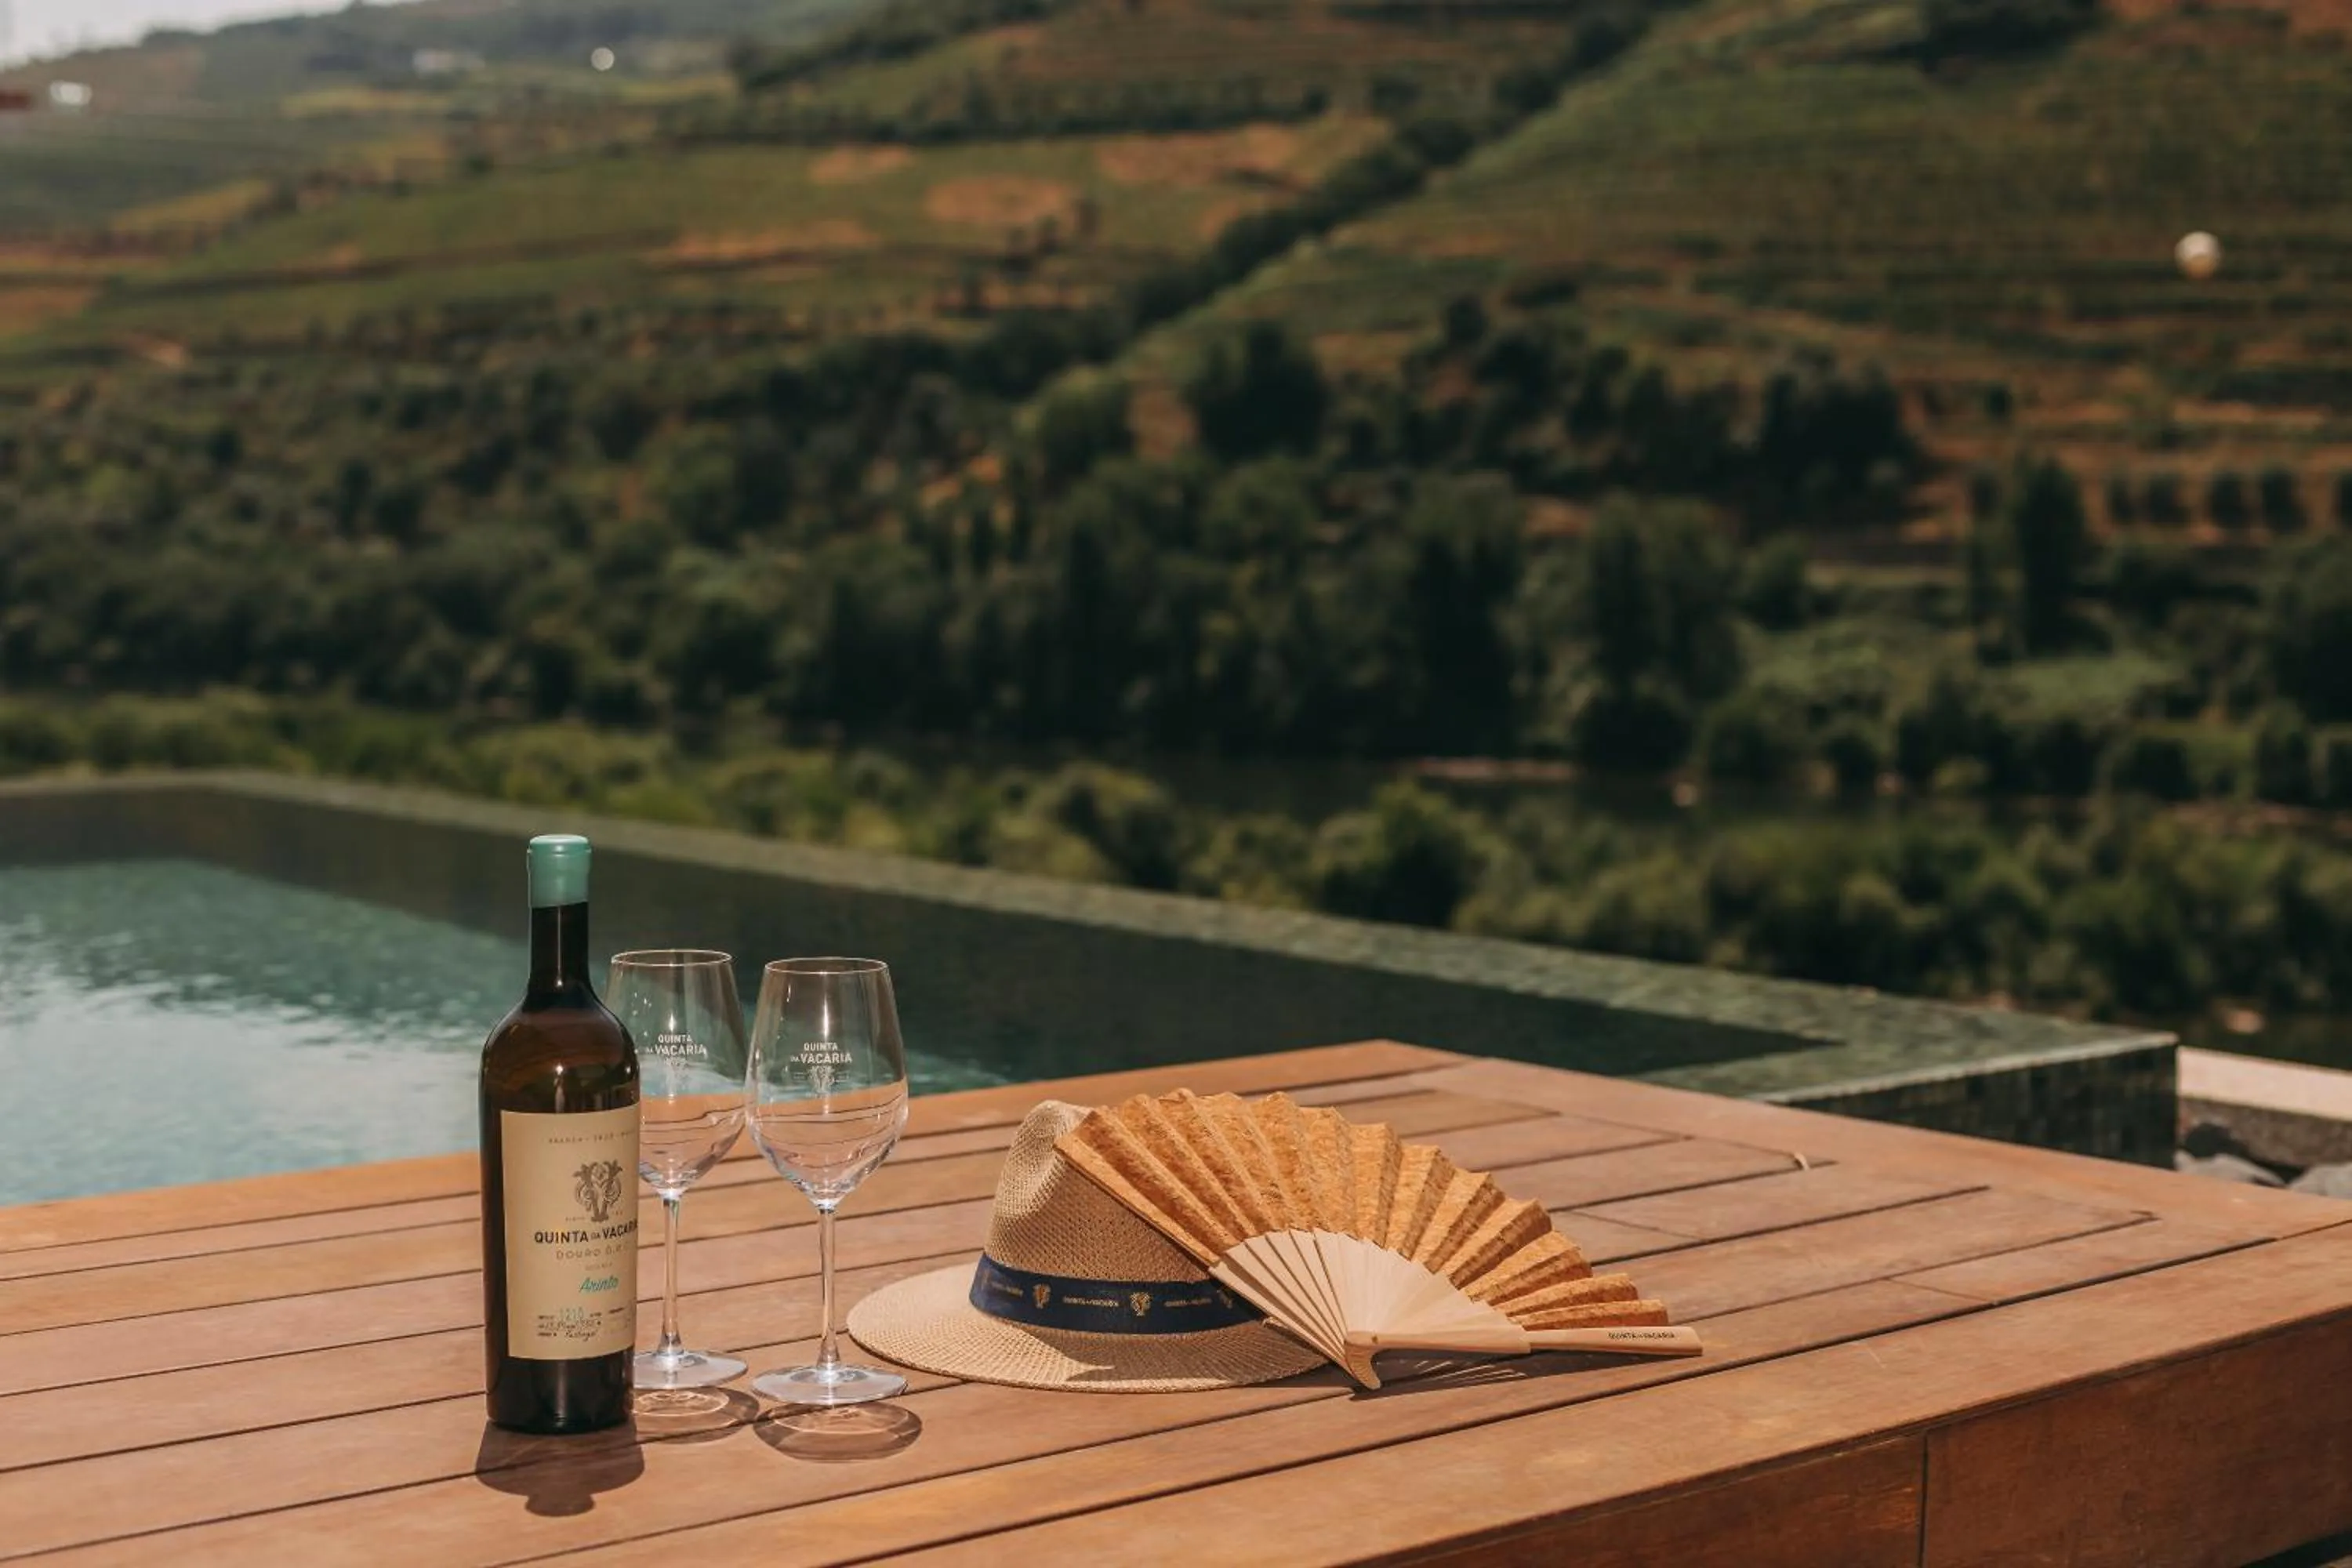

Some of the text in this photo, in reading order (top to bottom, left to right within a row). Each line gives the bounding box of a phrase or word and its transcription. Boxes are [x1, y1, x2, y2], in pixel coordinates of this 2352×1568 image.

[658, 1034, 692, 1044] QUINTA
[655, 1044, 706, 1055] VACARIA
[804, 1042, 838, 1051] QUINTA
[800, 1052, 853, 1064] VACARIA
[534, 1230, 589, 1244] QUINTA
